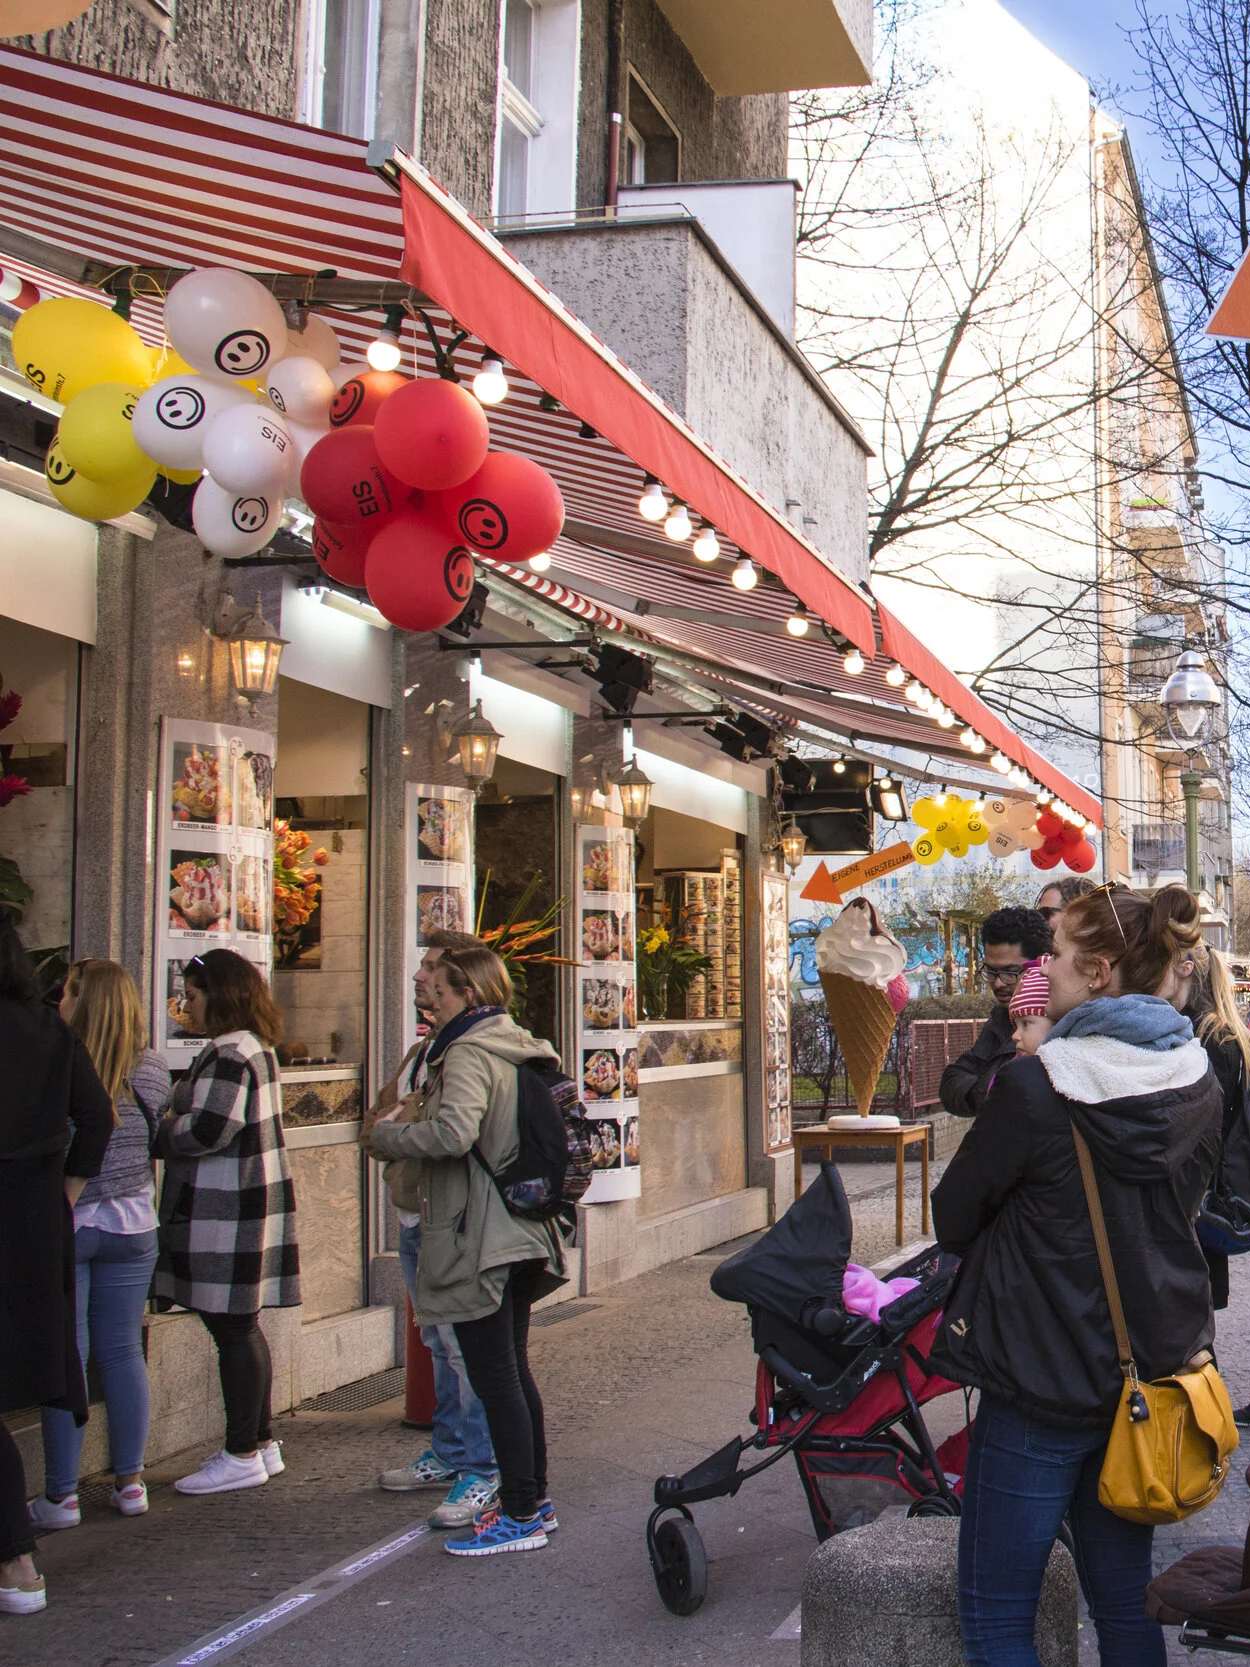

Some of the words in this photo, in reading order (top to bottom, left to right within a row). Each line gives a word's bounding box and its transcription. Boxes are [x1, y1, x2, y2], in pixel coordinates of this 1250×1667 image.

[25, 363, 46, 392] IS
[261, 426, 287, 453] EIS
[352, 480, 379, 517] EIS
[995, 836, 1009, 848] EIS
[831, 862, 860, 883] EIGENE
[863, 853, 914, 879] HERSTELLUNG
